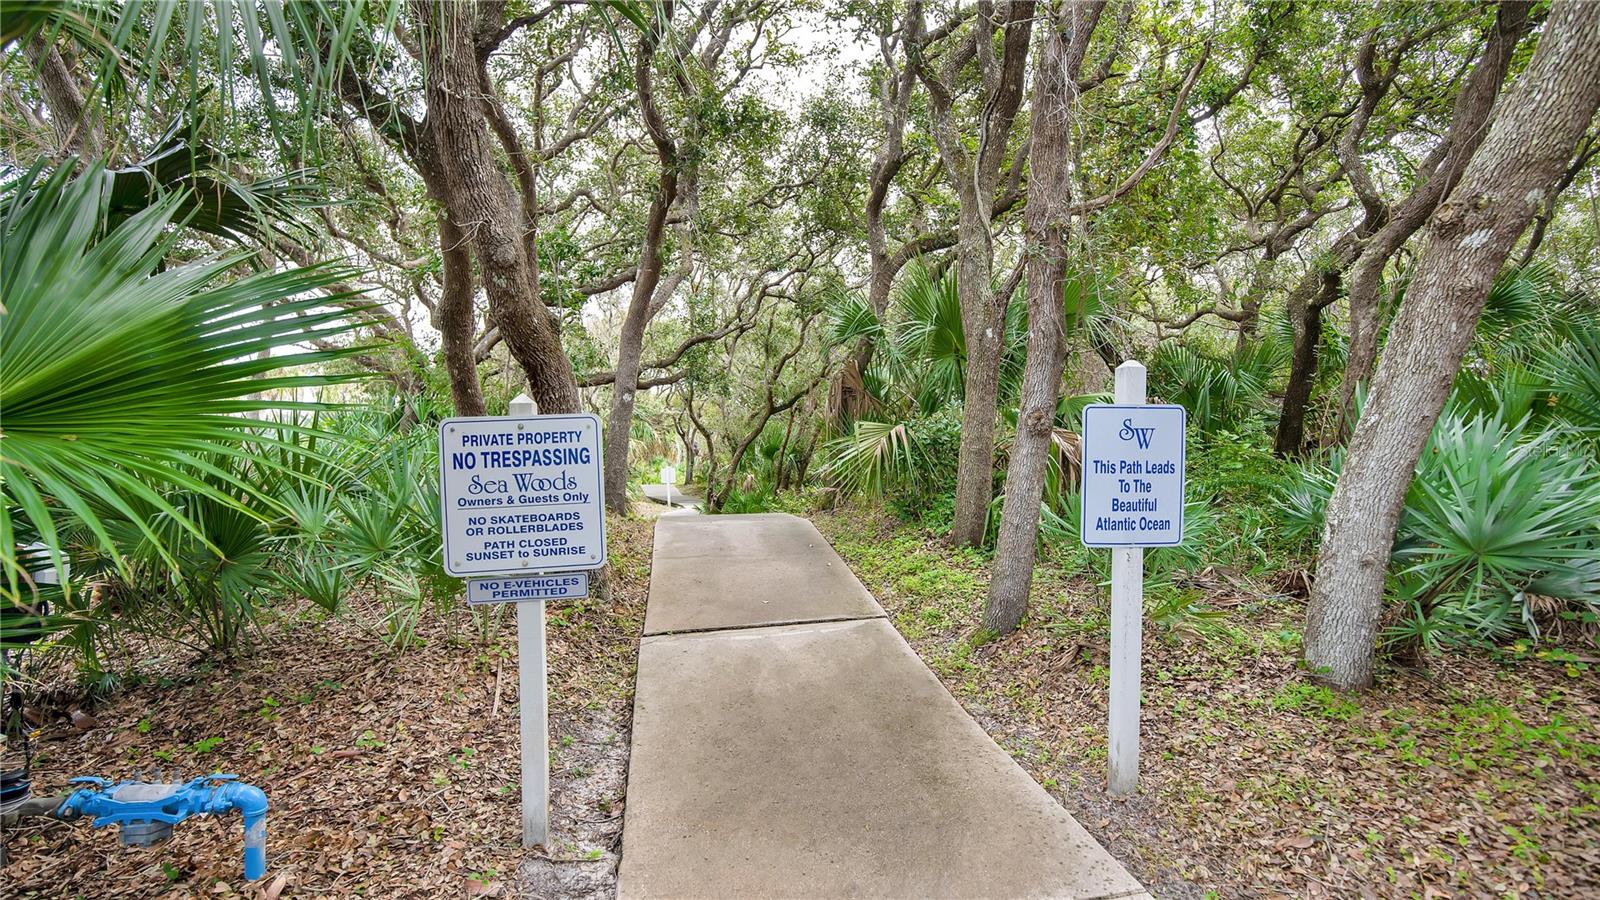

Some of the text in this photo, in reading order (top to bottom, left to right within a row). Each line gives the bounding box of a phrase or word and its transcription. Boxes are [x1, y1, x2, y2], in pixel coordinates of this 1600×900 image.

[462, 431, 582, 447] PRIVATE PROPERTY
[453, 447, 590, 469] NO TRESPASSING
[1094, 460, 1175, 474] This Path Leads
[468, 470, 577, 495] Sea Woods
[1119, 479, 1151, 493] To The
[458, 492, 589, 507] Owners & Guests Only
[1112, 498, 1157, 512] Beautiful
[469, 512, 580, 525] NO SKATEBOARDS
[1096, 517, 1170, 531] Atlantic Ocean
[466, 522, 584, 536] OR ROLLERBLADES
[484, 538, 567, 550] PATH CLOSED
[466, 546, 586, 561] SUNSET to SUNRISE
[480, 578, 579, 590] NO E-VEHICLES
[492, 588, 567, 598] PERMITTED
